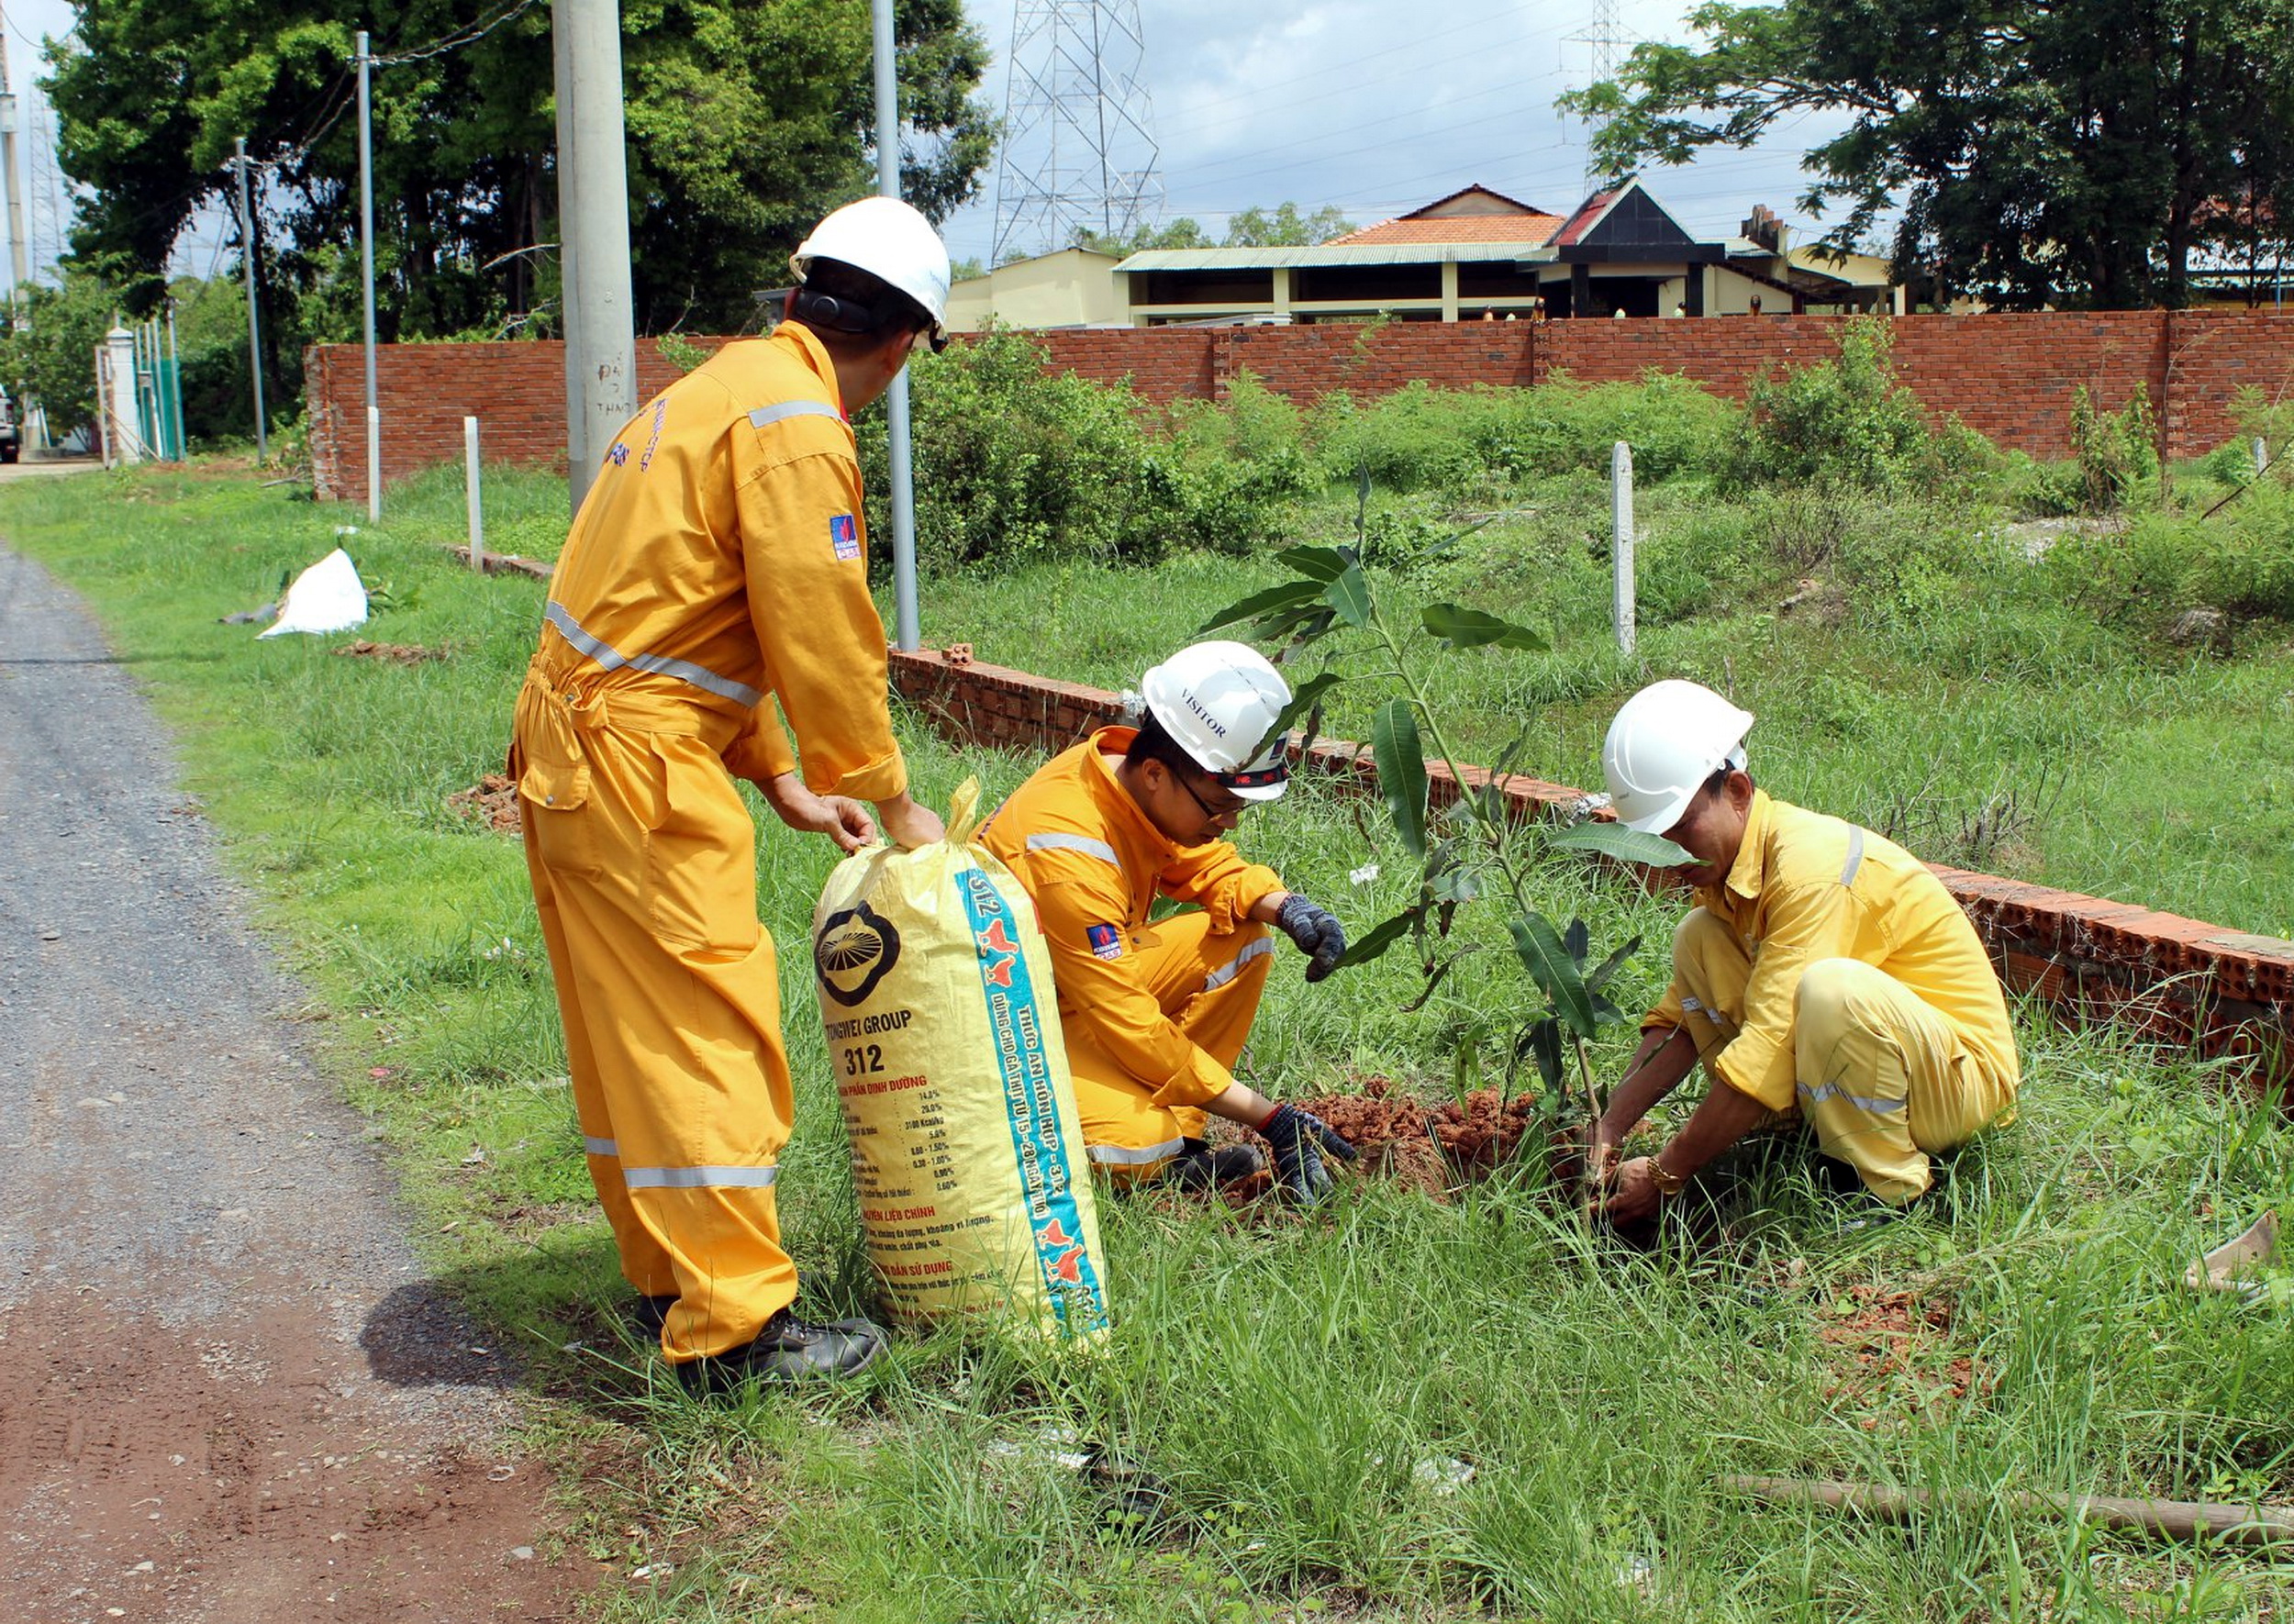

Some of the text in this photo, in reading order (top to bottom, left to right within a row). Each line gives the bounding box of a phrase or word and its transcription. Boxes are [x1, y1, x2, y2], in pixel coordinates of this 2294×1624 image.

[1181, 688, 1227, 739] VISITOR
[971, 877, 1002, 917] 312
[863, 1010, 911, 1034] GROUP
[845, 1044, 885, 1076] 312
[1000, 1029, 1016, 1053] CHO
[1022, 1143, 1035, 1157] 28
